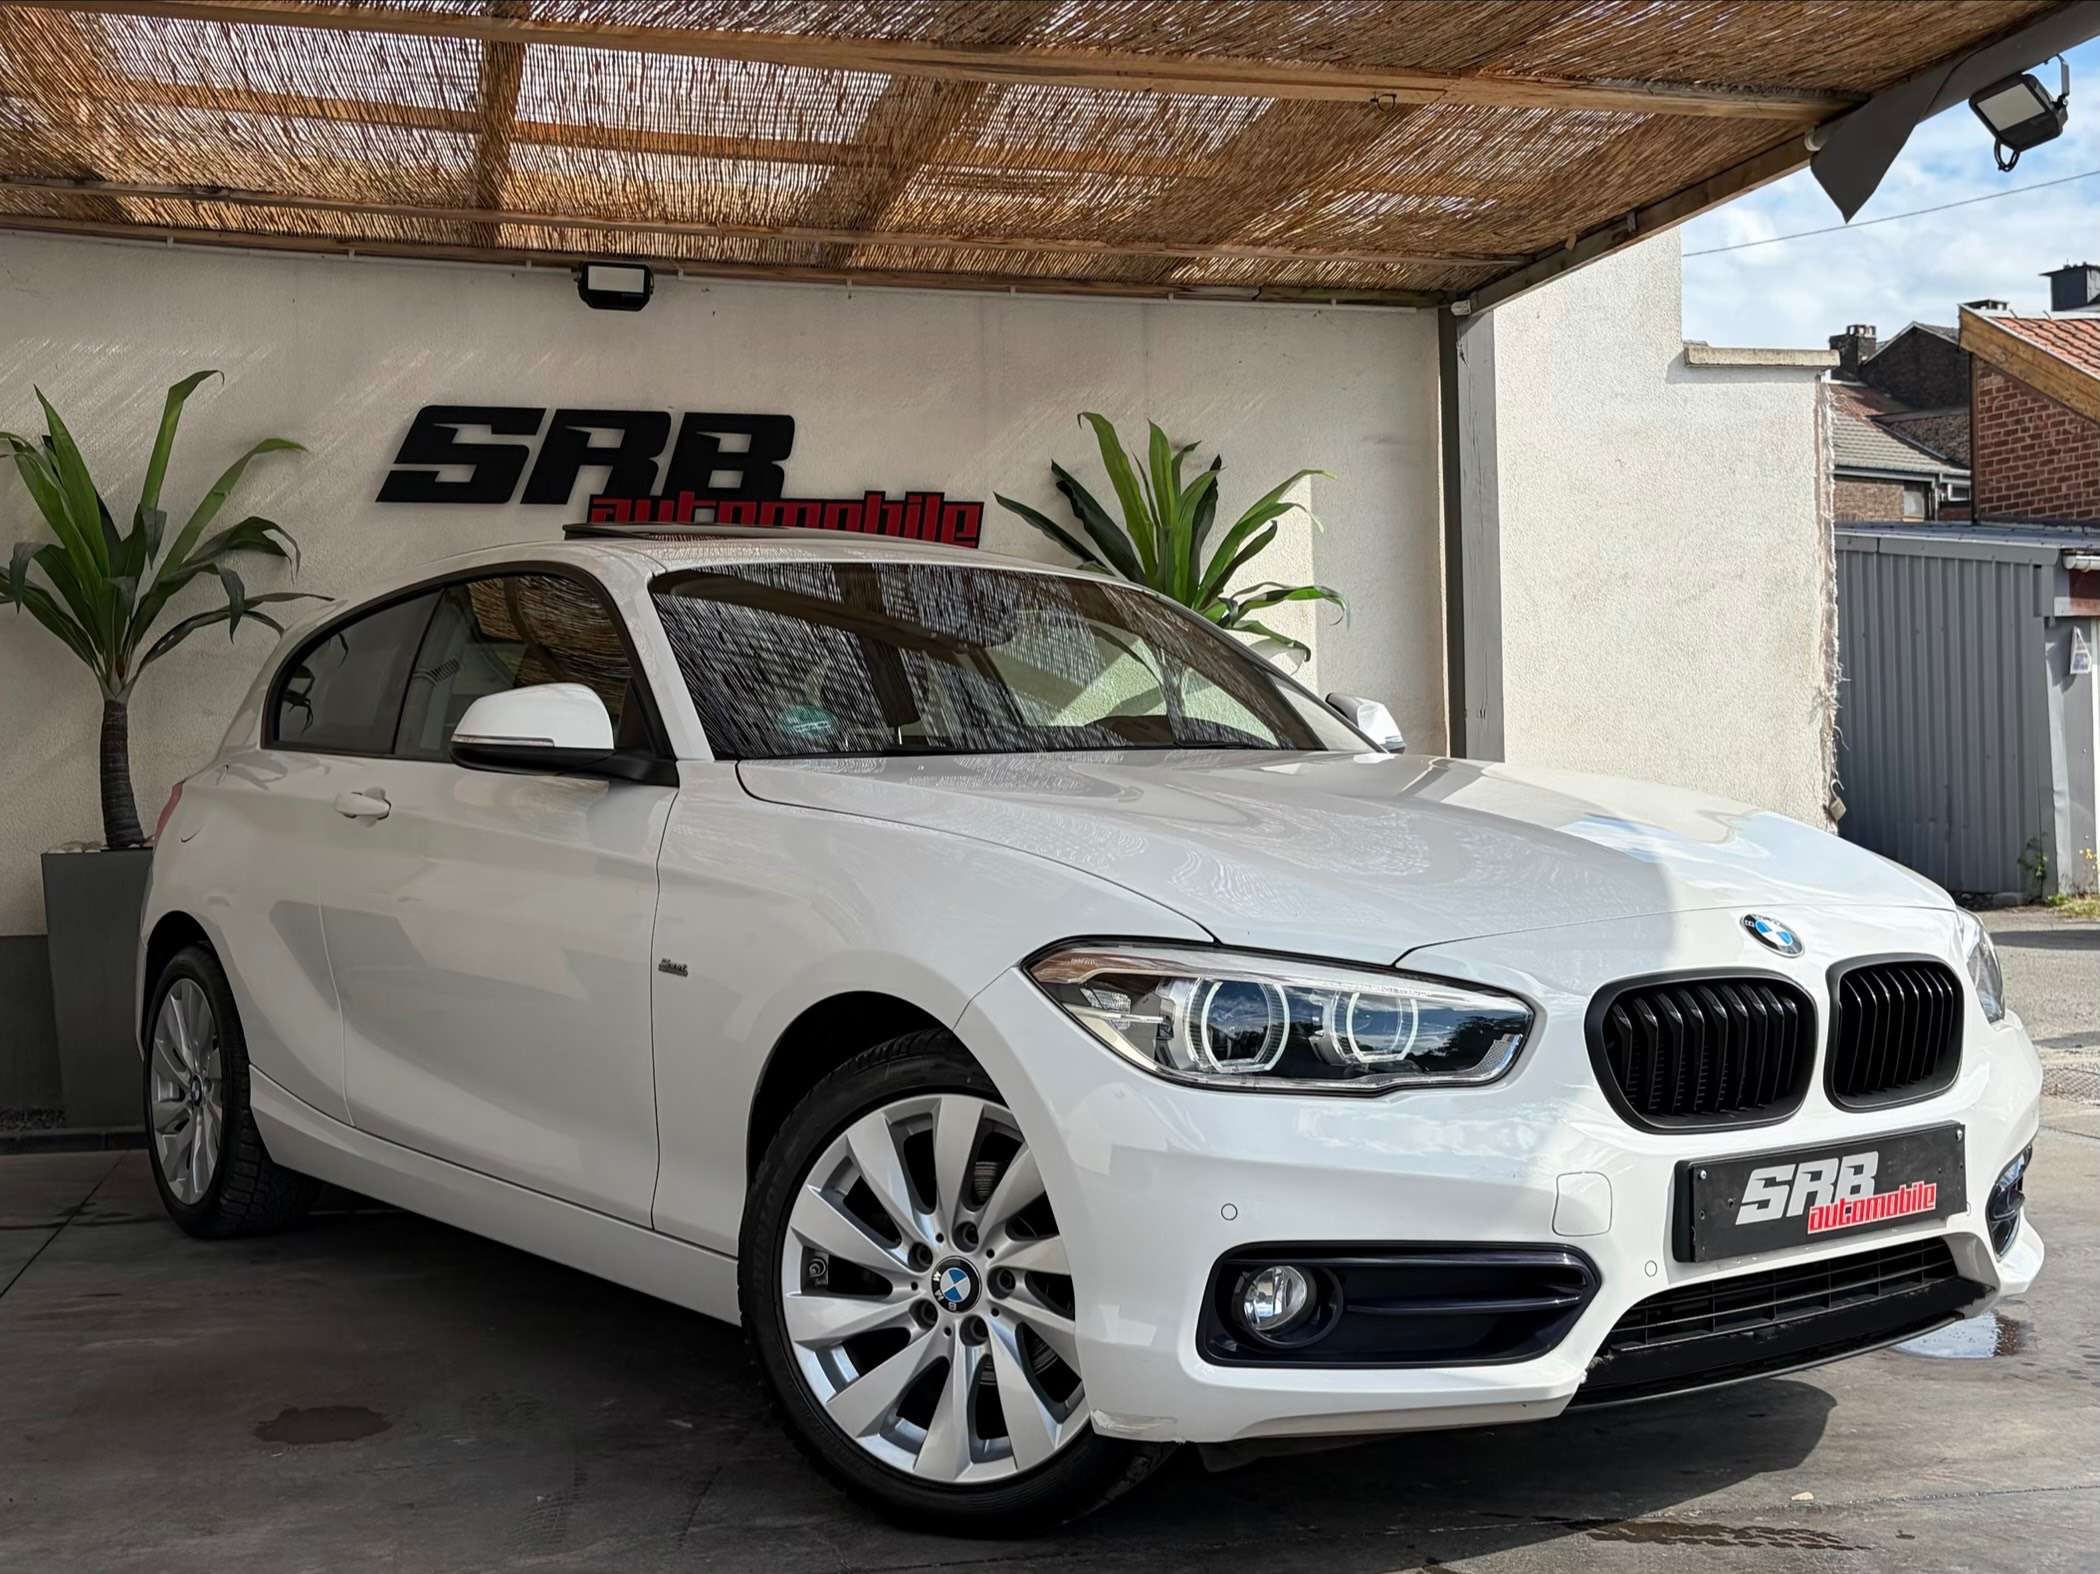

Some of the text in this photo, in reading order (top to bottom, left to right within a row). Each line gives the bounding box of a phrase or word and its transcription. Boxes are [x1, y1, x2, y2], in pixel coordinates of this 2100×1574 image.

[376, 405, 796, 504] SRB
[1735, 1151, 1879, 1225] SRB
[1807, 1181, 1937, 1234] automobile
